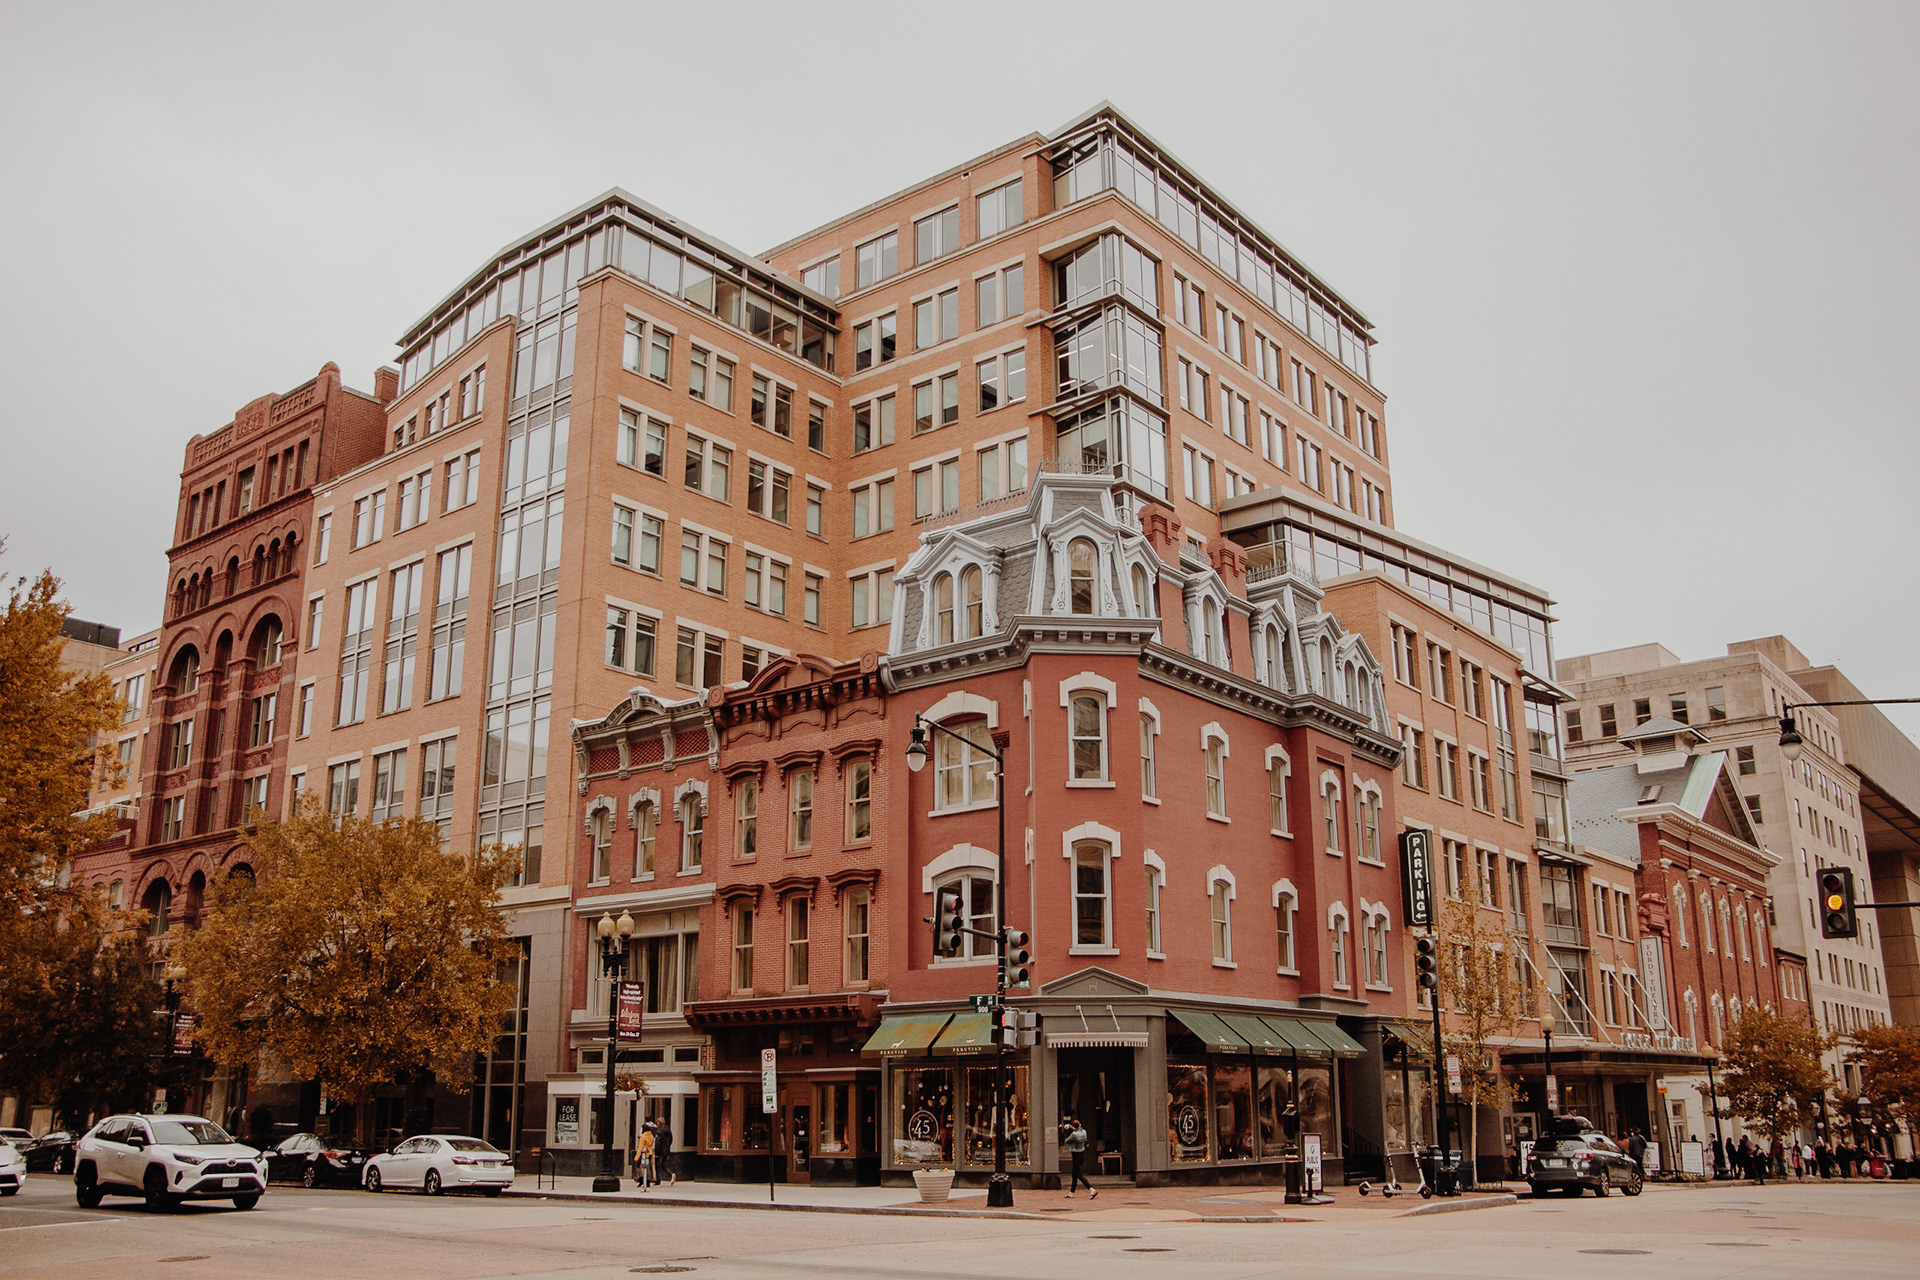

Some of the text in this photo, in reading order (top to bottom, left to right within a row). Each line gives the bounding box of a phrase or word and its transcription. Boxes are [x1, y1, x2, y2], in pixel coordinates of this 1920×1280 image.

[1412, 837, 1425, 911] PARKING
[1646, 944, 1655, 976] FORD'S
[976, 996, 982, 1005] F
[1649, 979, 1660, 1024] THEATRE
[559, 1113, 577, 1122] LEASE
[562, 1105, 575, 1114] FOR
[914, 1119, 930, 1138] 45
[1182, 1114, 1194, 1134] 45
[1306, 1156, 1319, 1164] PUBLIC
